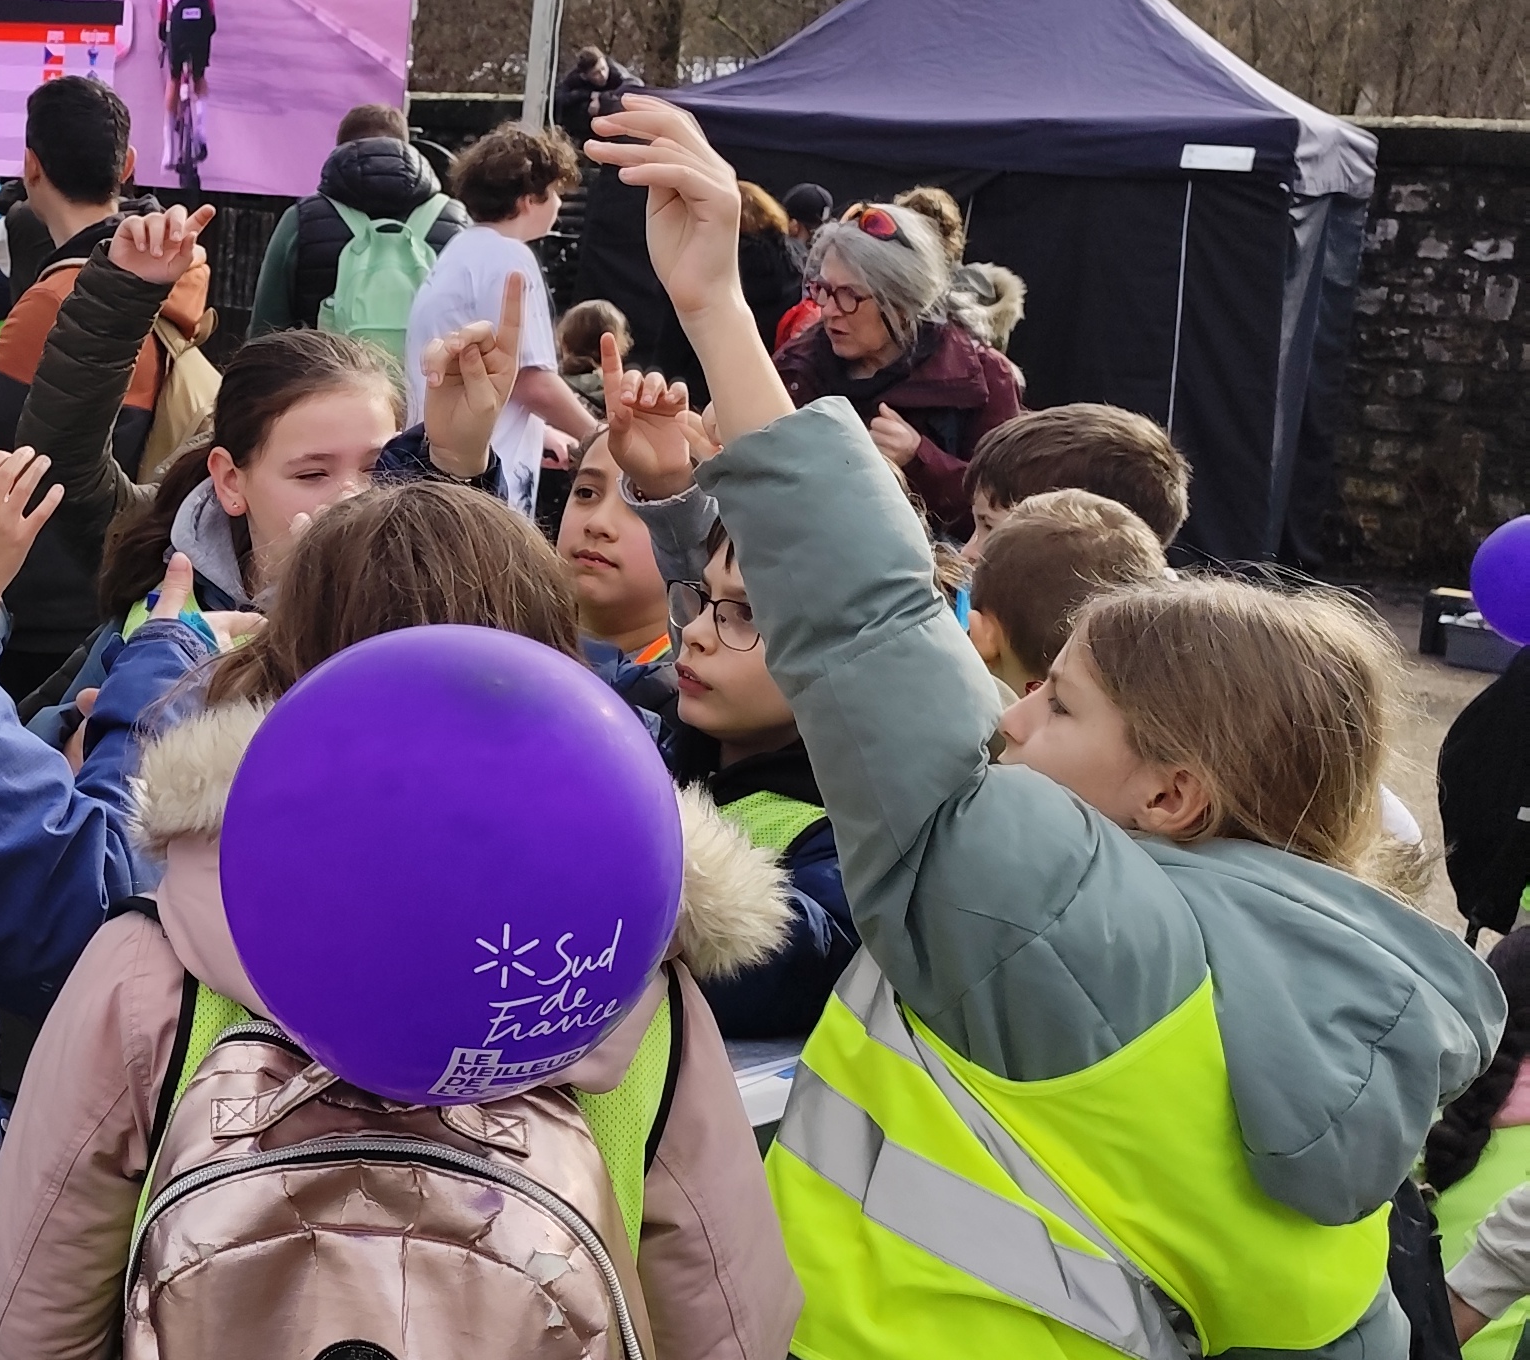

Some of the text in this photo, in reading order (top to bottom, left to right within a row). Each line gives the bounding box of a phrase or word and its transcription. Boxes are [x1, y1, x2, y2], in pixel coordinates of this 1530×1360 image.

[536, 918, 623, 986] Sud
[539, 978, 593, 1016] de
[482, 994, 622, 1048] France
[452, 1049, 581, 1077] MEILLEUR
[459, 1052, 493, 1066] LE
[444, 1076, 484, 1087] DE
